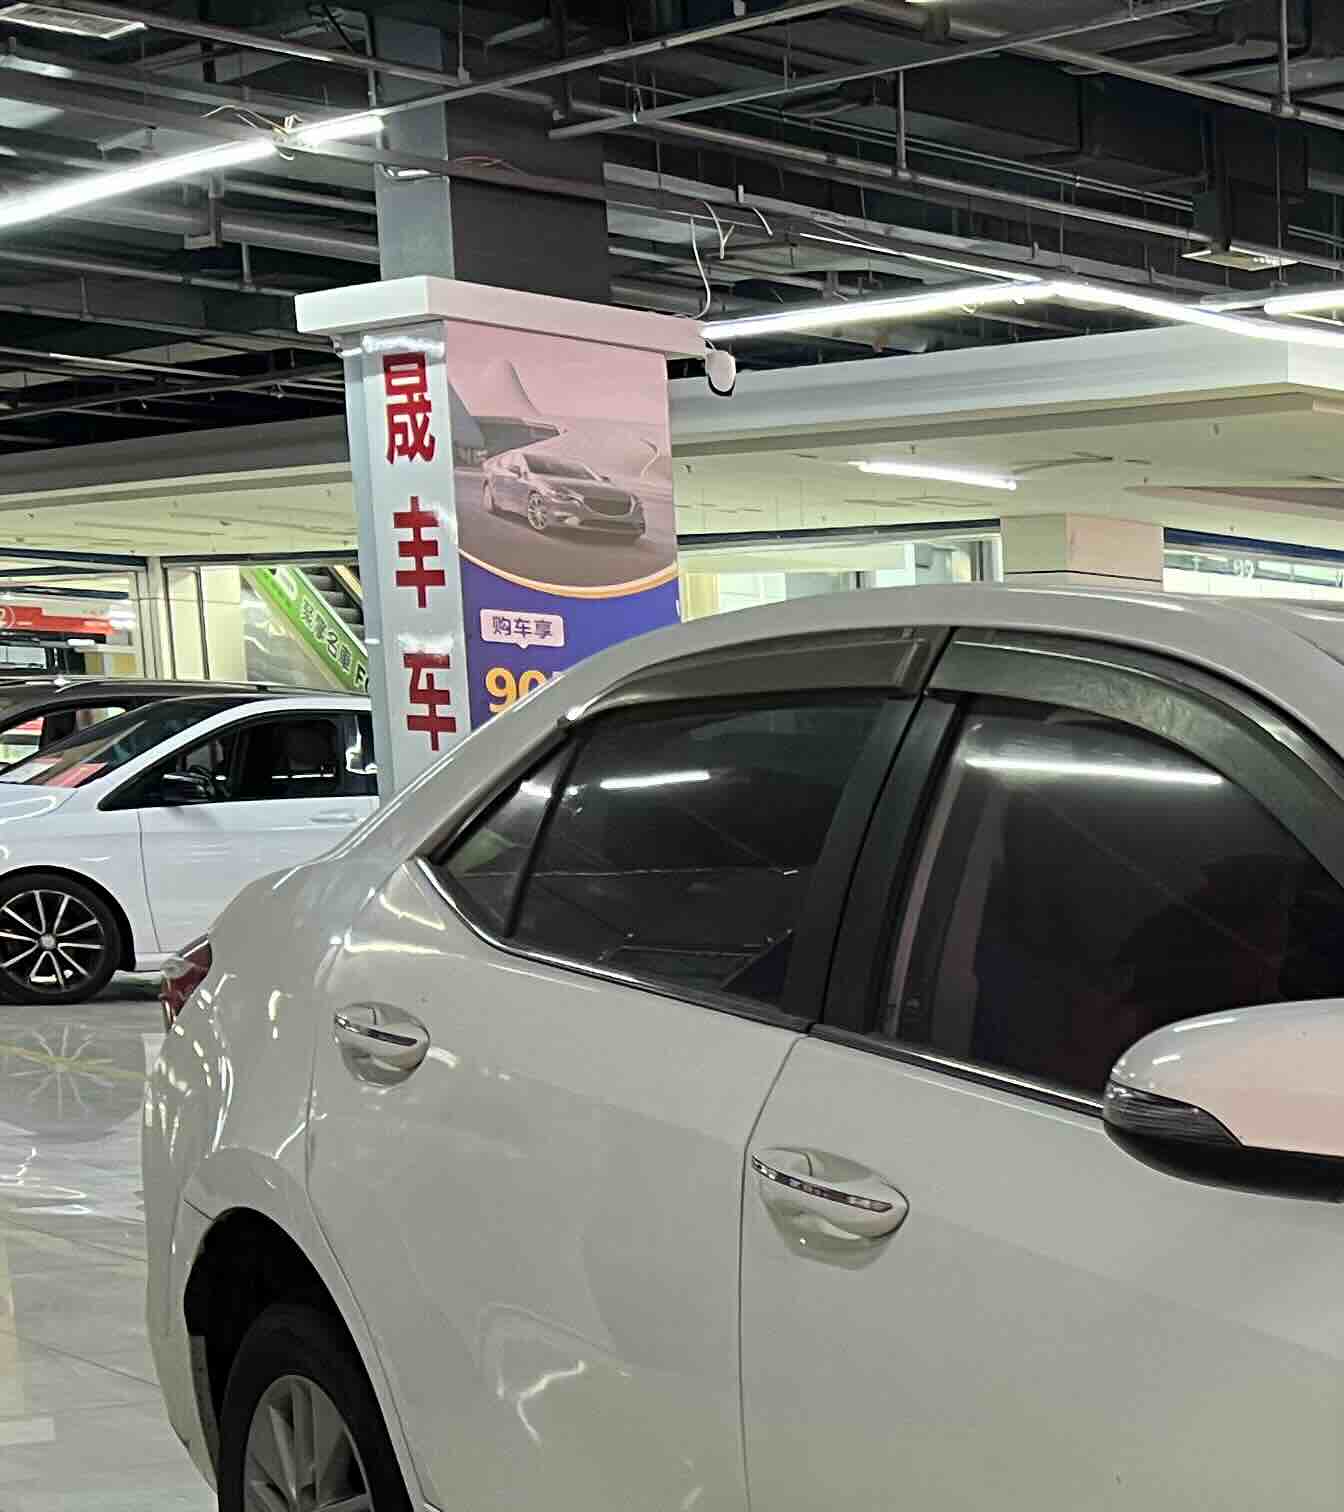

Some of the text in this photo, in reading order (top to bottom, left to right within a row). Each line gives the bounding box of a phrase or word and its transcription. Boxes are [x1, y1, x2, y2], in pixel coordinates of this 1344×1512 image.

[383, 352, 457, 751] 晟丰车
[492, 615, 553, 640] 购车享
